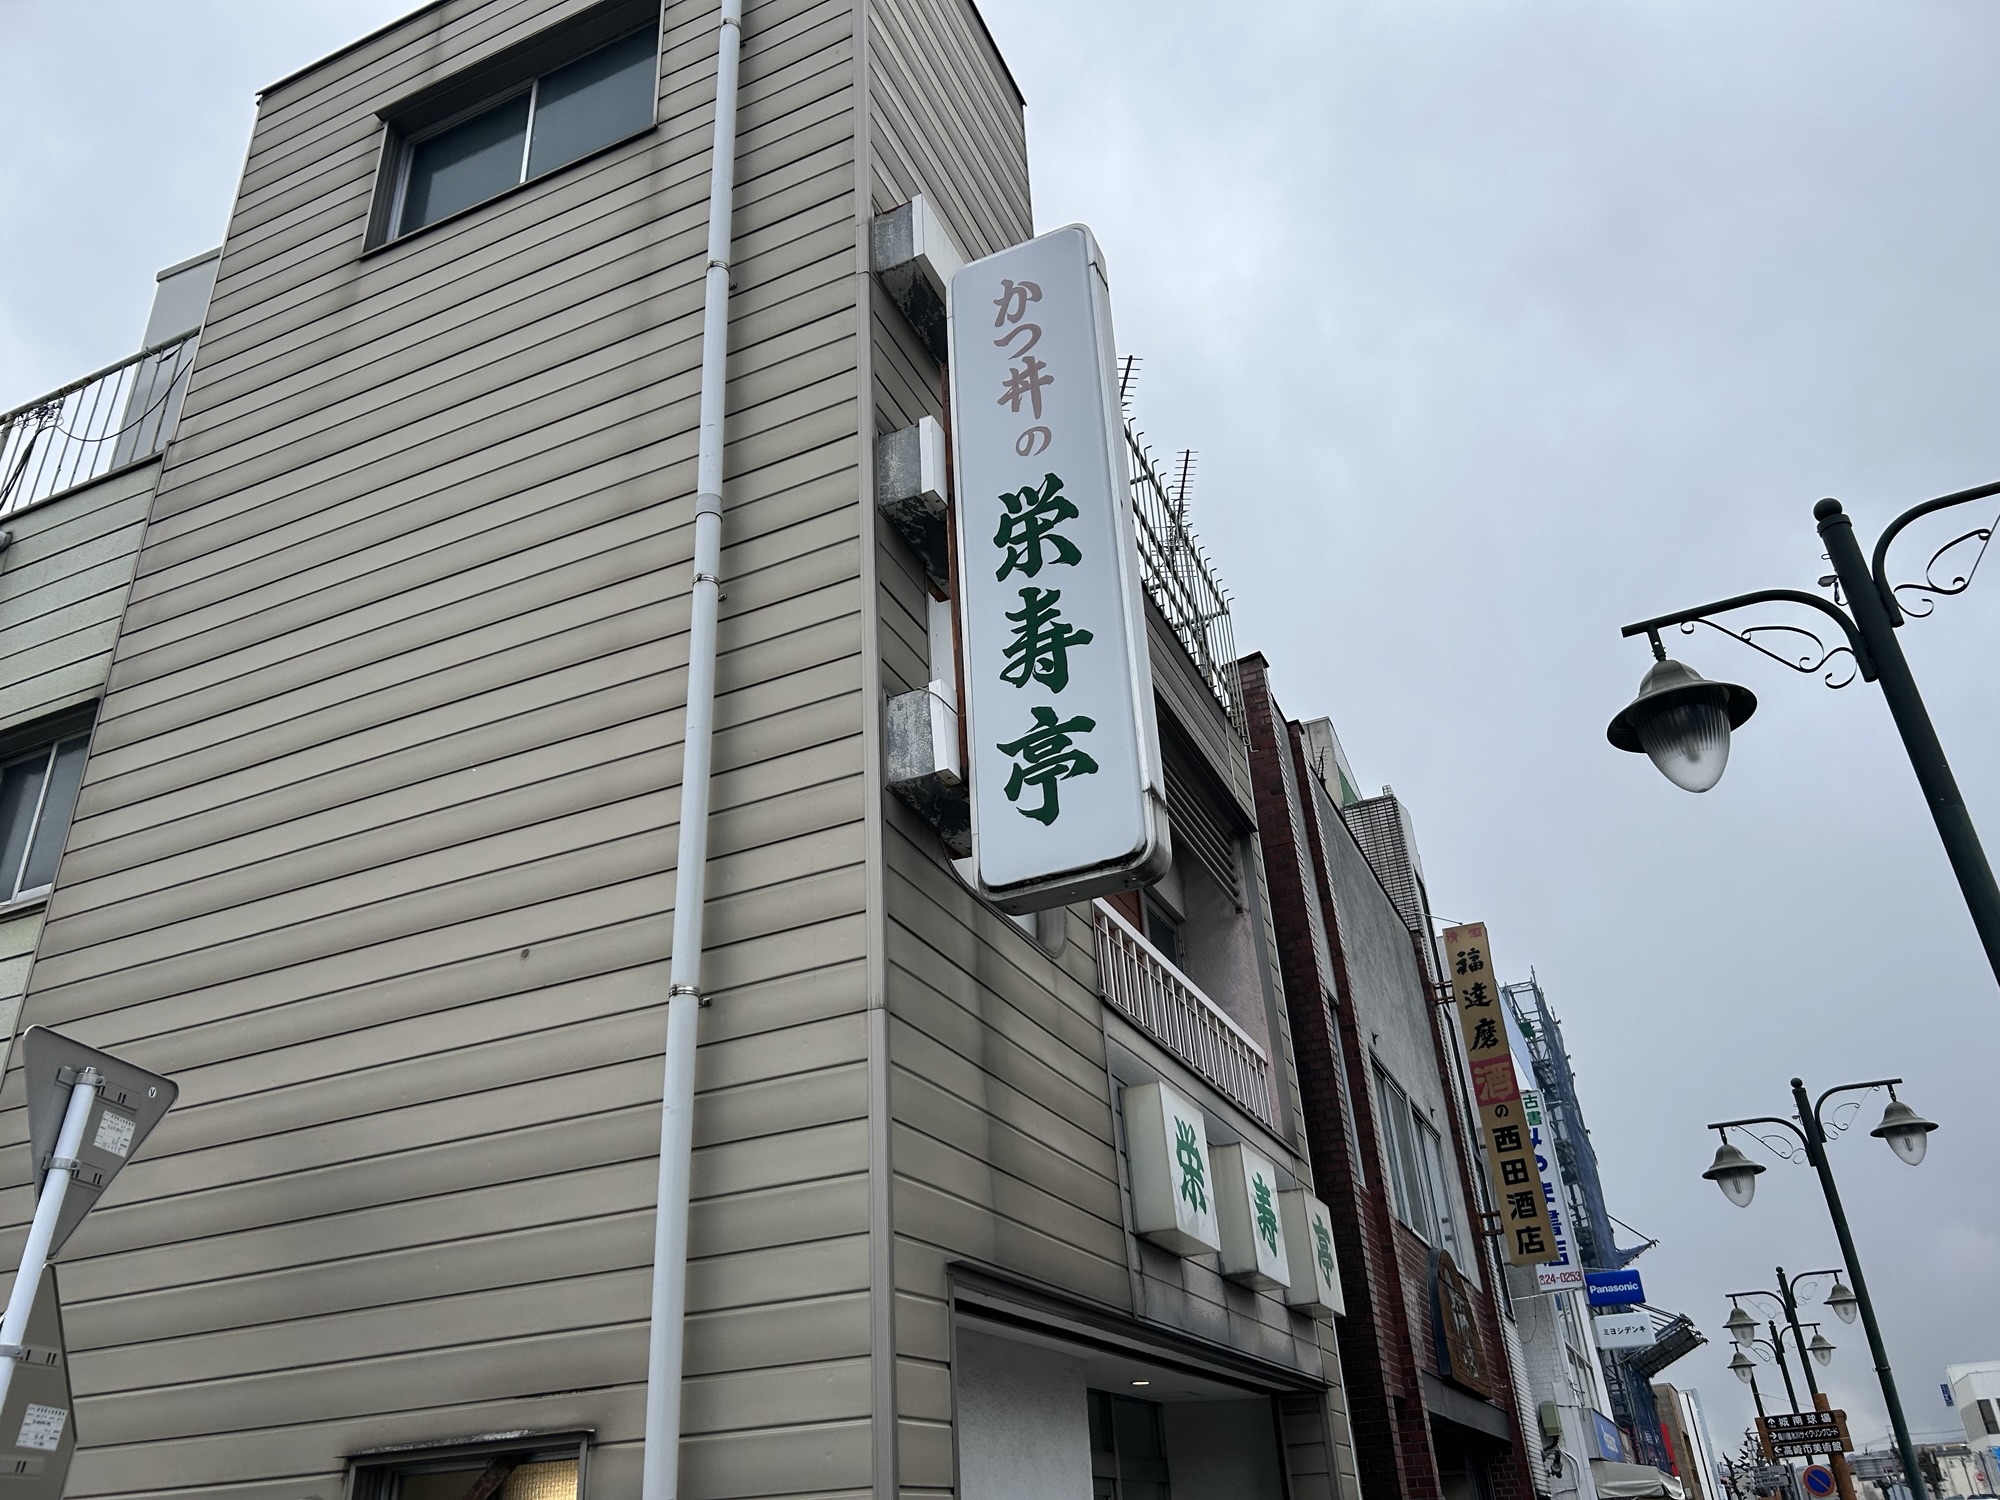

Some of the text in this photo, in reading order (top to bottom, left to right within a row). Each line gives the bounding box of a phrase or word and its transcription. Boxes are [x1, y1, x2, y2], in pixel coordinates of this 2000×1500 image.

[993, 278, 1055, 457] かつ丼の
[993, 472, 1100, 828] 栄寿亭
[1456, 948, 1499, 1052] 福達磨
[1173, 1115, 1335, 1290] 栄 寿 亭
[1589, 1281, 1639, 1294] Panasonic
[1603, 1325, 1646, 1336] ミヨシデンキ
[1778, 1412, 1832, 1427] 城南球場
[1783, 1441, 1843, 1456] 高崎市美術館
